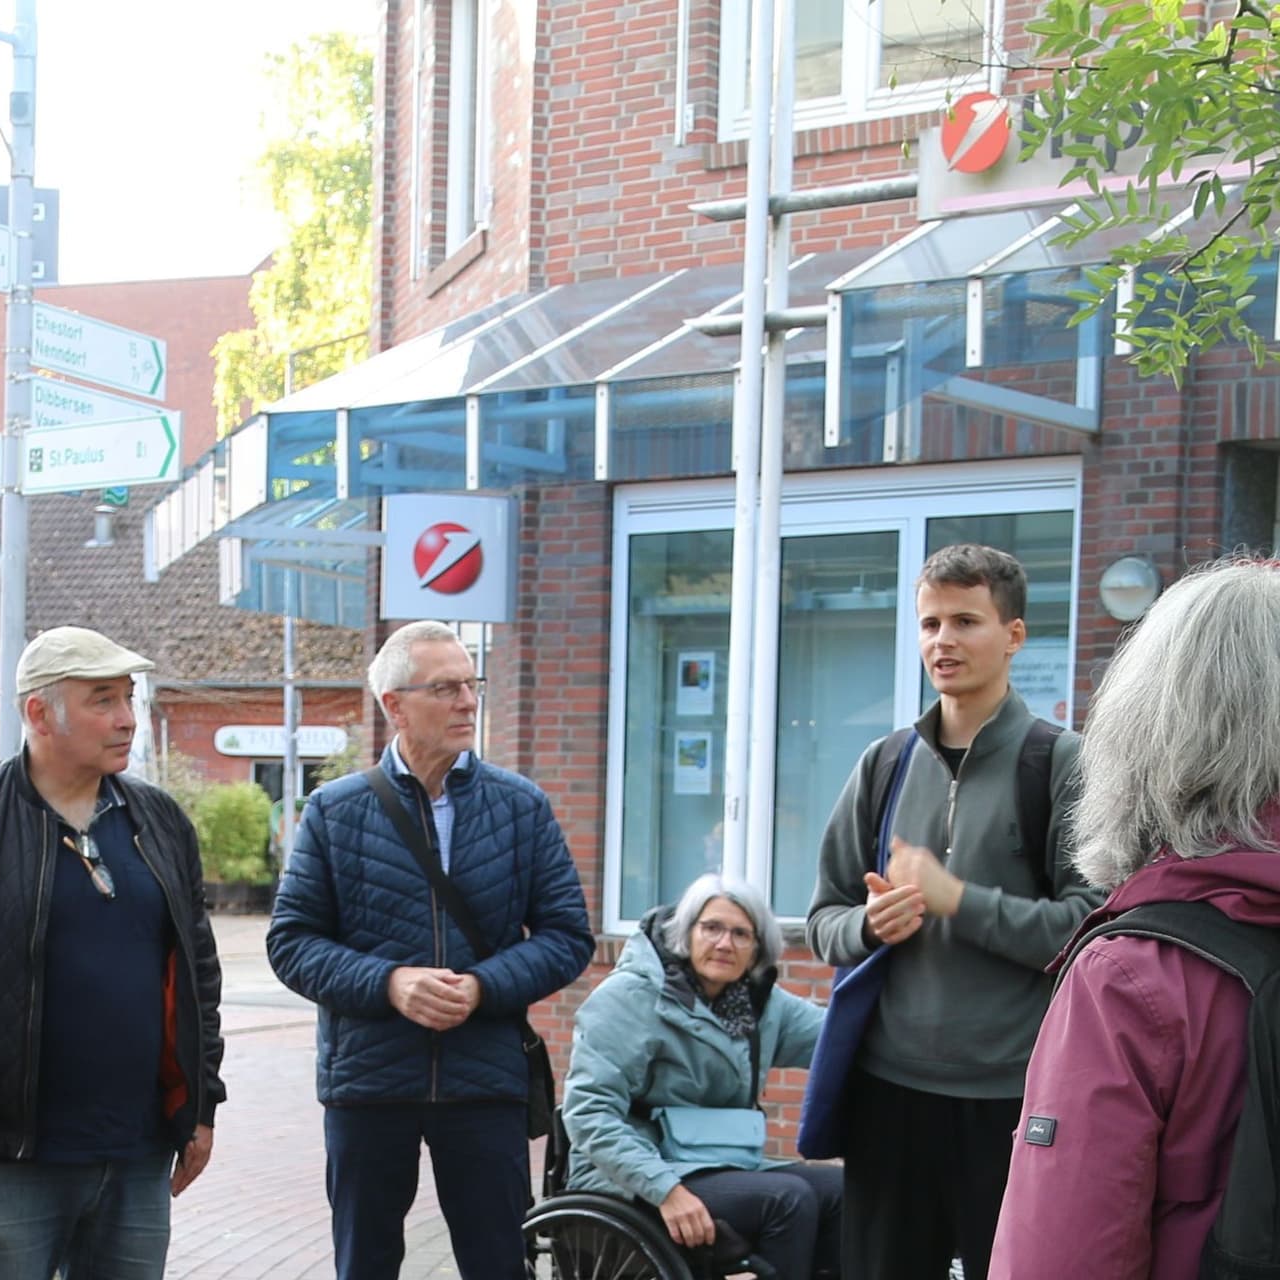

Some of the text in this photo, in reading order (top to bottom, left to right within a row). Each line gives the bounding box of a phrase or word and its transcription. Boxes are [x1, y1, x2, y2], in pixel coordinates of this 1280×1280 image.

[35, 312, 83, 340] Ehestorf
[35, 338, 87, 368] Nenndorf
[35, 385, 95, 416] Dibbersen
